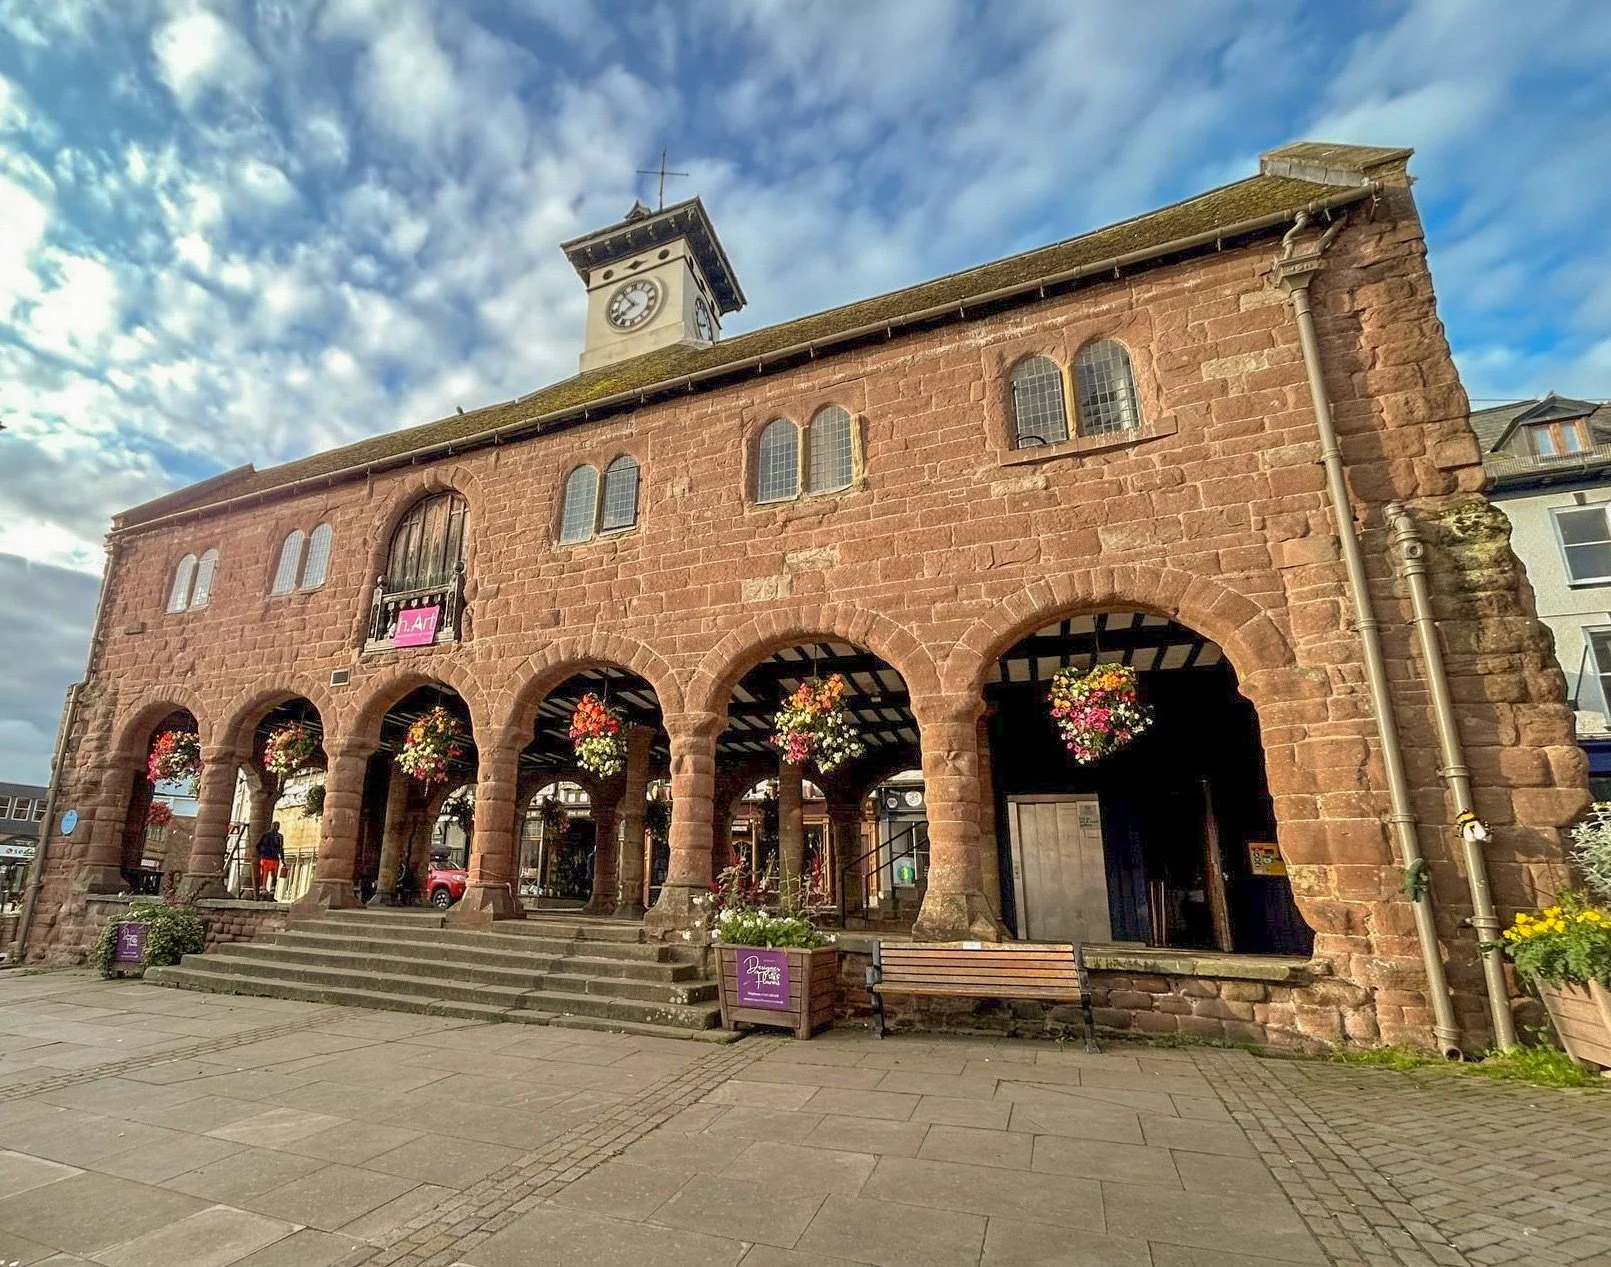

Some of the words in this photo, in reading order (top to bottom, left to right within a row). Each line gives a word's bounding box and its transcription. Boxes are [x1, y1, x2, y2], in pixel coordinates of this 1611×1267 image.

[397, 612, 436, 633] h.Art
[743, 955, 781, 975] Designer
[754, 970, 781, 990] Flowers
